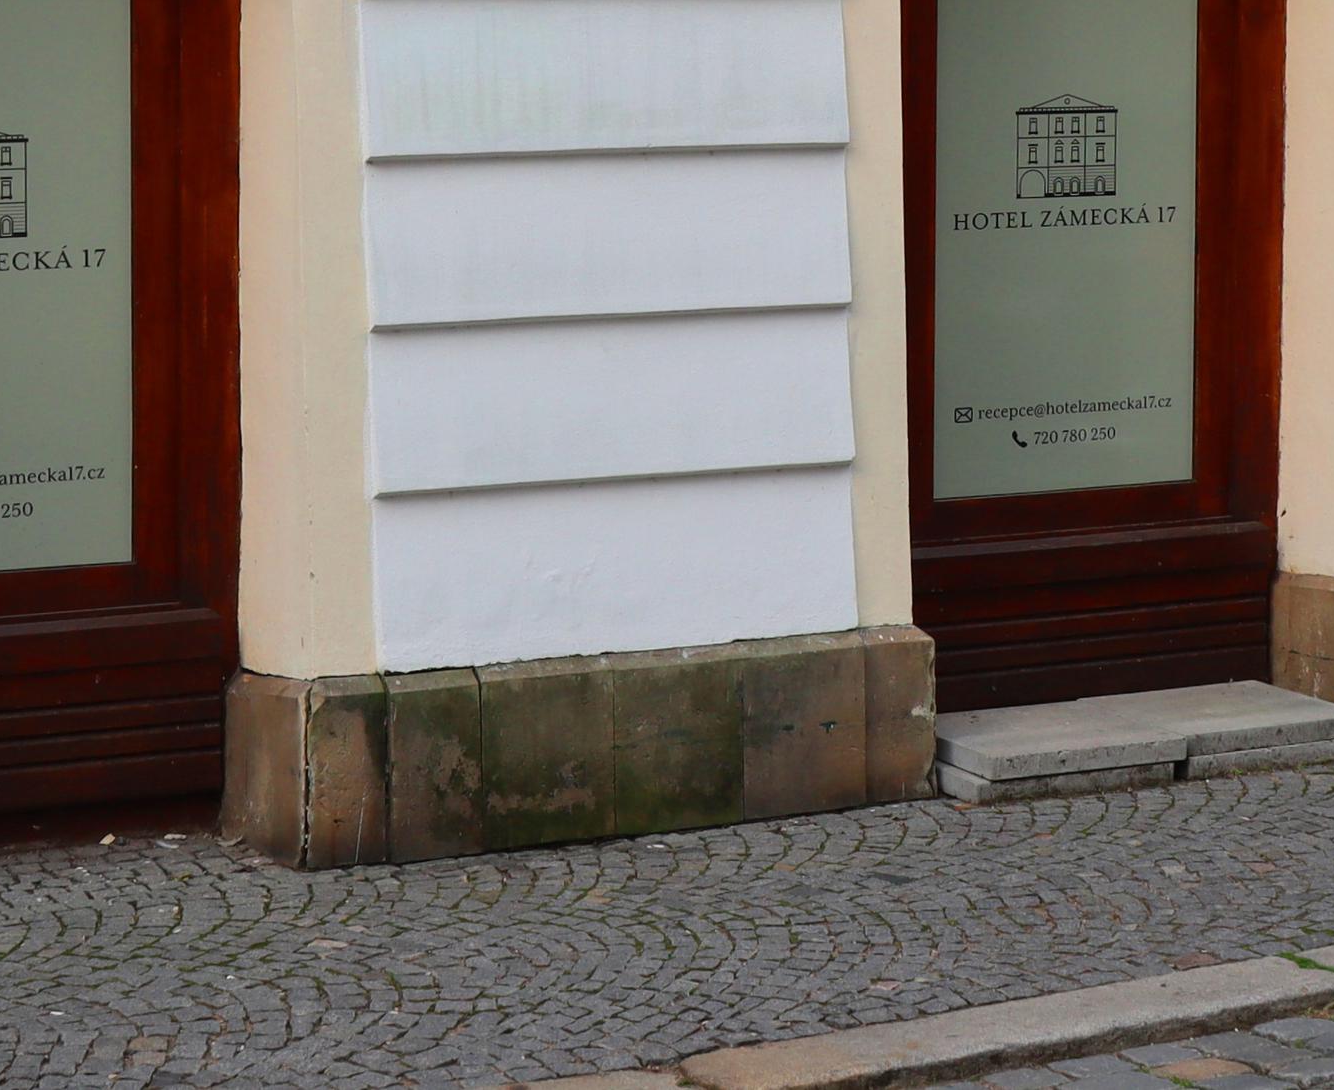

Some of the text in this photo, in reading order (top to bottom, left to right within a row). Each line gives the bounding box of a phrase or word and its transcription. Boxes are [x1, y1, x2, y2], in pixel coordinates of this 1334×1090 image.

[953, 203, 1176, 230] HOTEL ZÁMECKÁ 17
[82, 248, 106, 268] 17
[978, 396, 1172, 421] recepce@hotelzamecka17.cz
[1033, 426, 1116, 445] 720 780 250
[1, 502, 34, 519] 250
